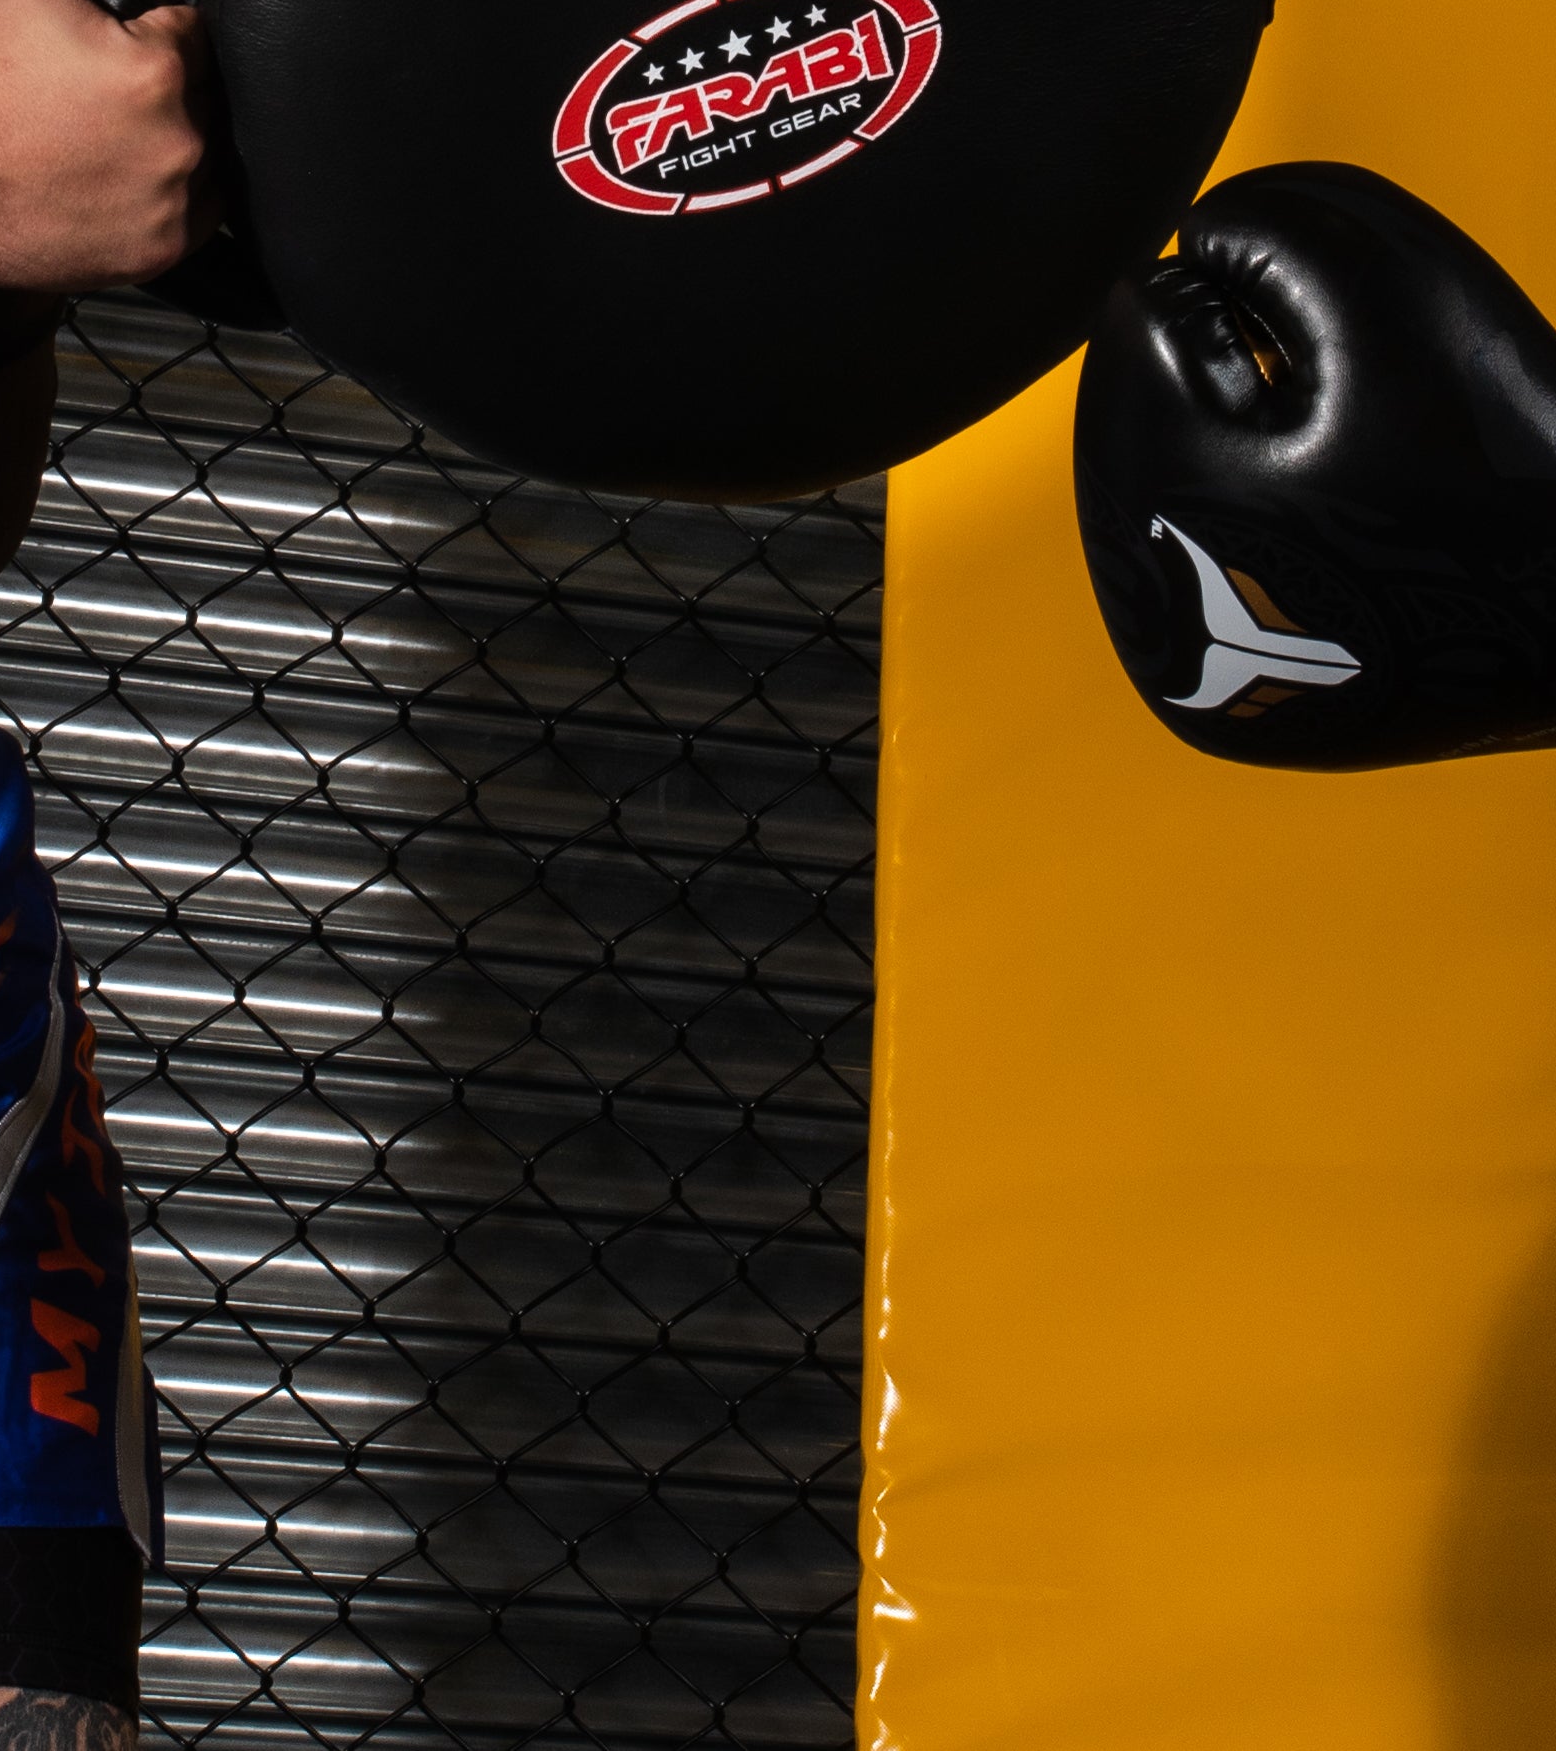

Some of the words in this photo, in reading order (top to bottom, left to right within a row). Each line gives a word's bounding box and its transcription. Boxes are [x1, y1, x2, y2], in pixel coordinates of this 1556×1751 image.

[605, 9, 895, 175] FARABI
[657, 128, 757, 180] FIGHT
[768, 92, 863, 140] GEAR
